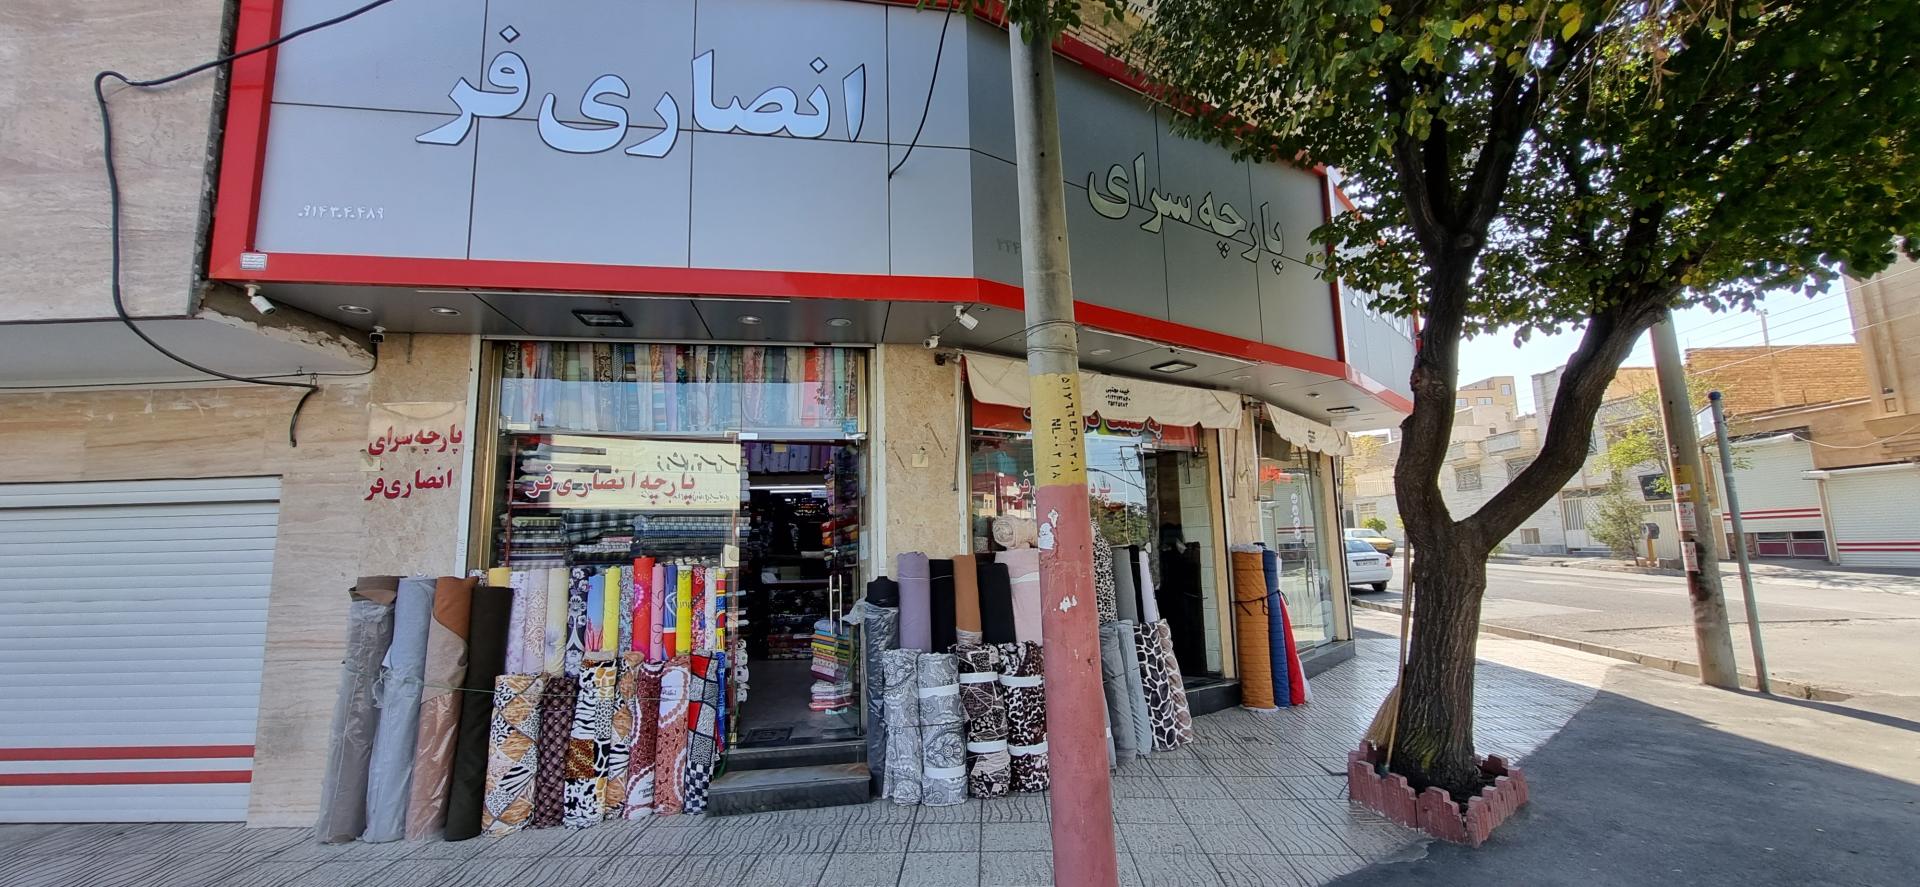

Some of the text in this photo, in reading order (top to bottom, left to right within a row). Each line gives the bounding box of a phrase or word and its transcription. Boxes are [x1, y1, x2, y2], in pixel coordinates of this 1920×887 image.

[415, 24, 866, 159] انصاری فر
[1086, 151, 1285, 276] پارچه سرای
[367, 423, 464, 456] پارچه سرای
[364, 466, 453, 501] انصاری فر
[525, 464, 554, 498] فر
[556, 468, 637, 498] انصاری
[639, 472, 696, 505] پارچه
